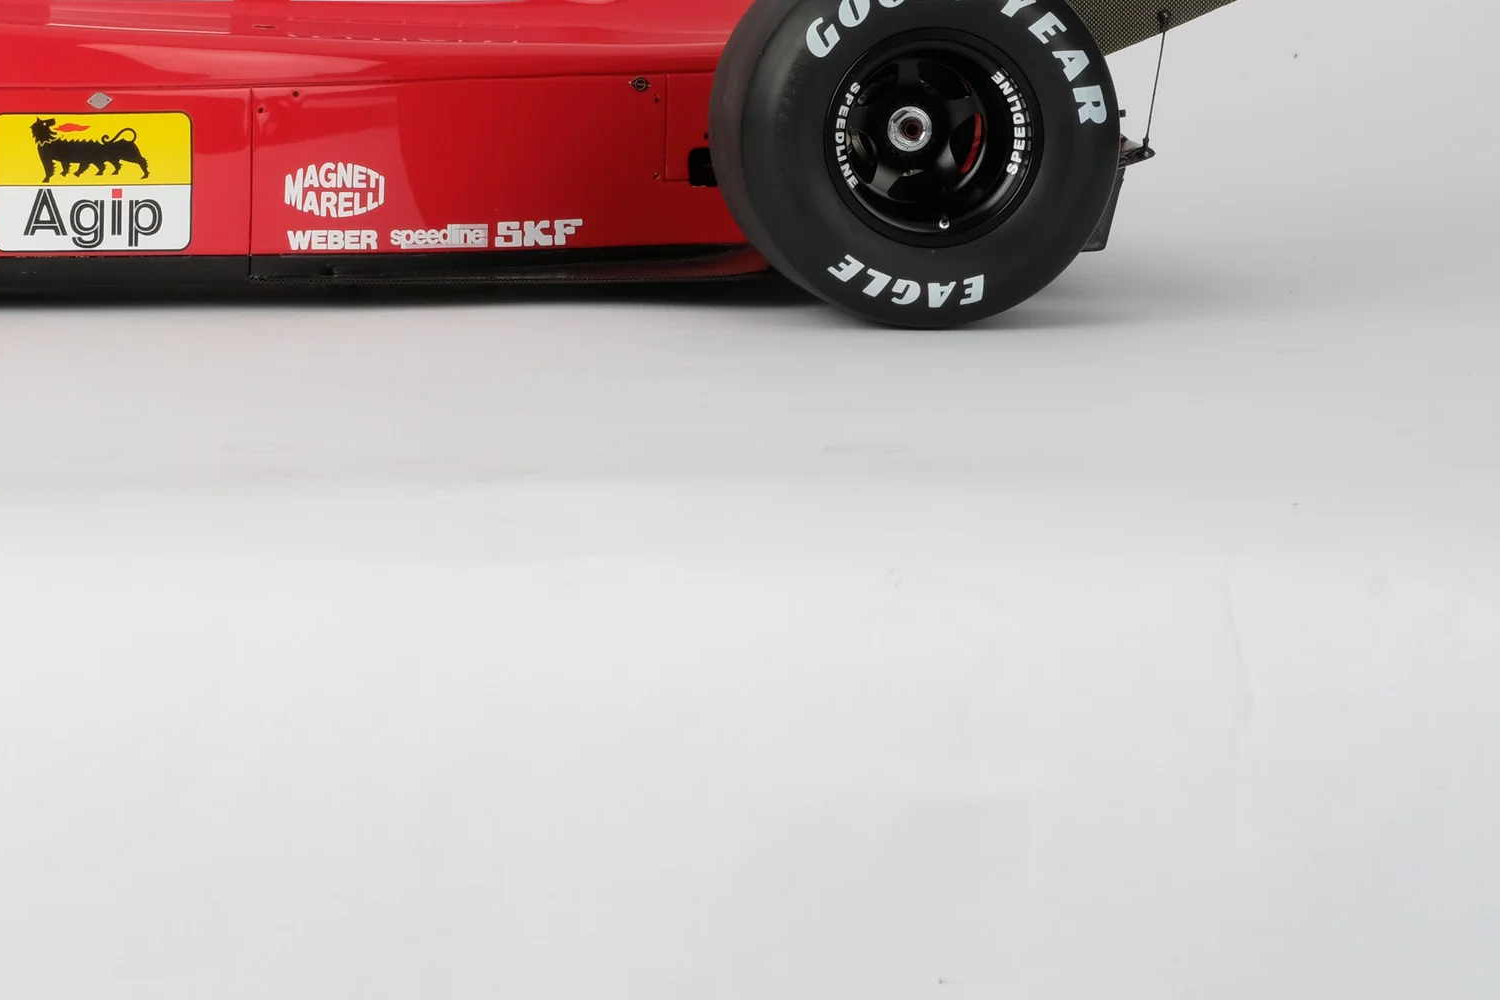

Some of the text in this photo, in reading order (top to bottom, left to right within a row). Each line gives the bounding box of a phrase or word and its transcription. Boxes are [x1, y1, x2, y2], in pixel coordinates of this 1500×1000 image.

[835, 82, 861, 189] SPEEDLINE
[990, 71, 1026, 176] SPEEDLINE
[284, 161, 385, 200] MAGNETI
[284, 180, 385, 219] MARELLI
[23, 188, 163, 249] Agip
[287, 218, 583, 250] WEBER speedline SKF
[827, 254, 985, 308] EAGLE
